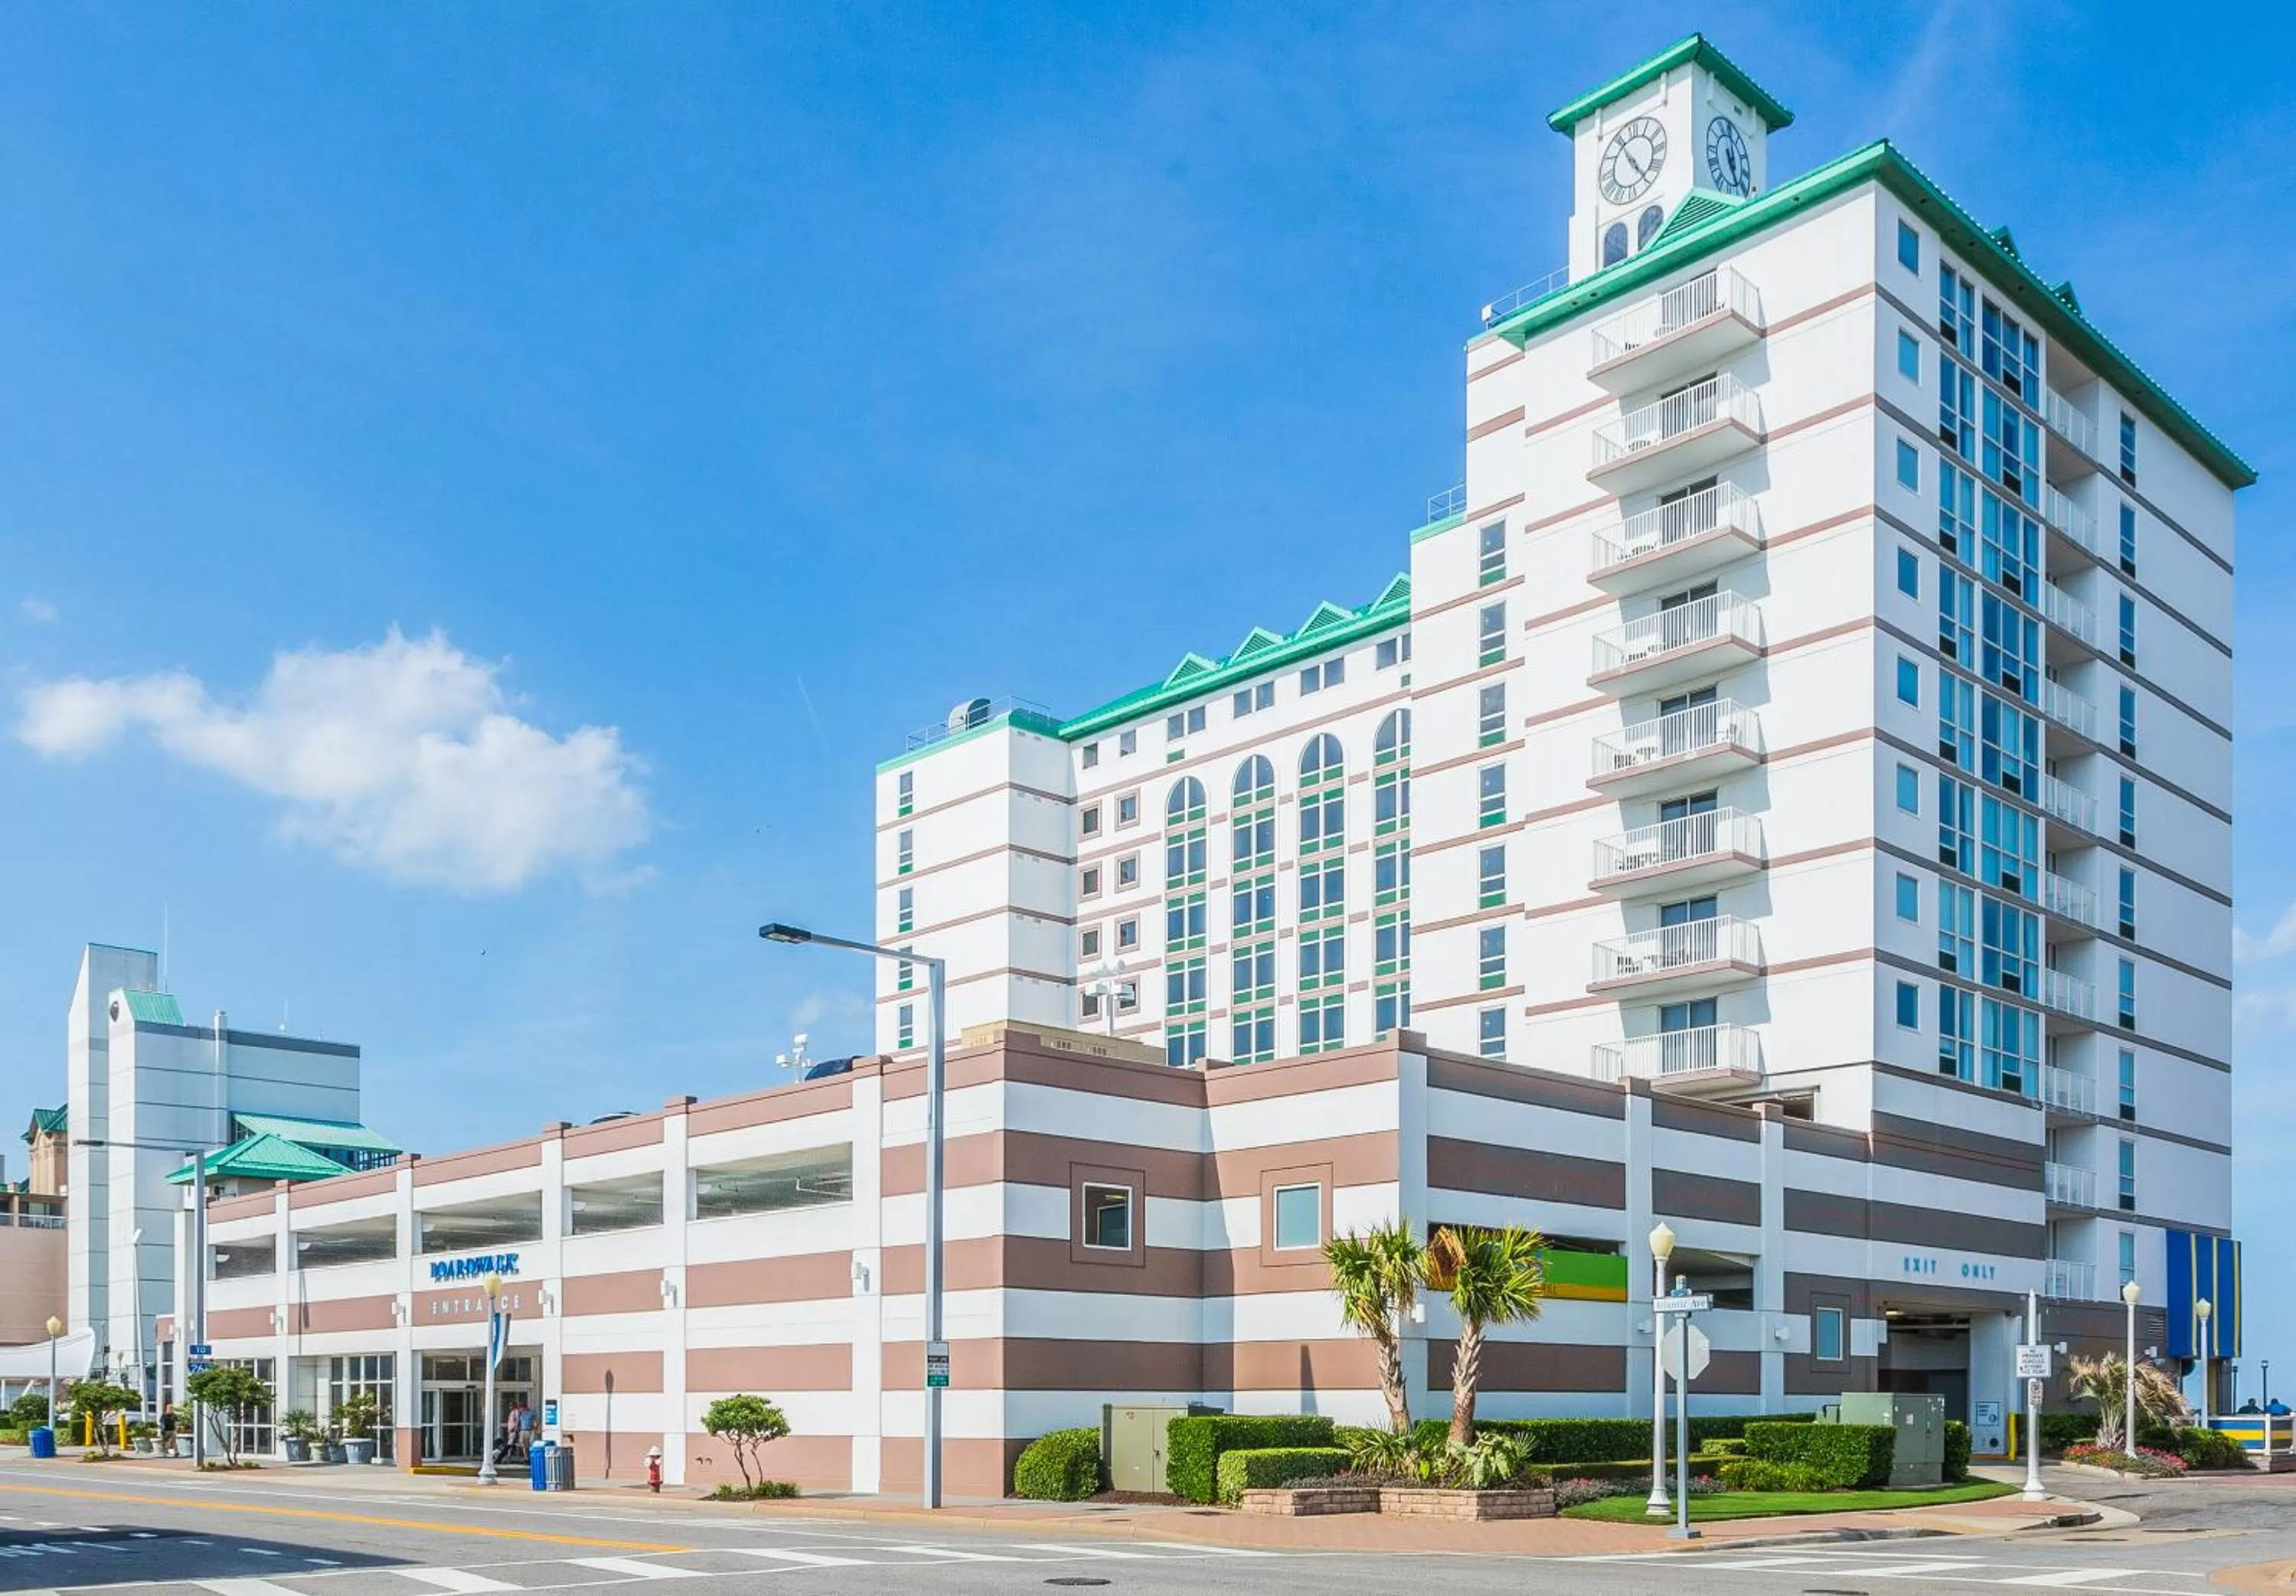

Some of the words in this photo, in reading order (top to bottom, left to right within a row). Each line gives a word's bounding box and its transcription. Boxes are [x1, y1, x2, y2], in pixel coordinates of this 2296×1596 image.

[1904, 1257, 1936, 1274] EXIT
[1961, 1263, 1995, 1280] ONLY
[432, 1294, 521, 1314] ENTRACE
